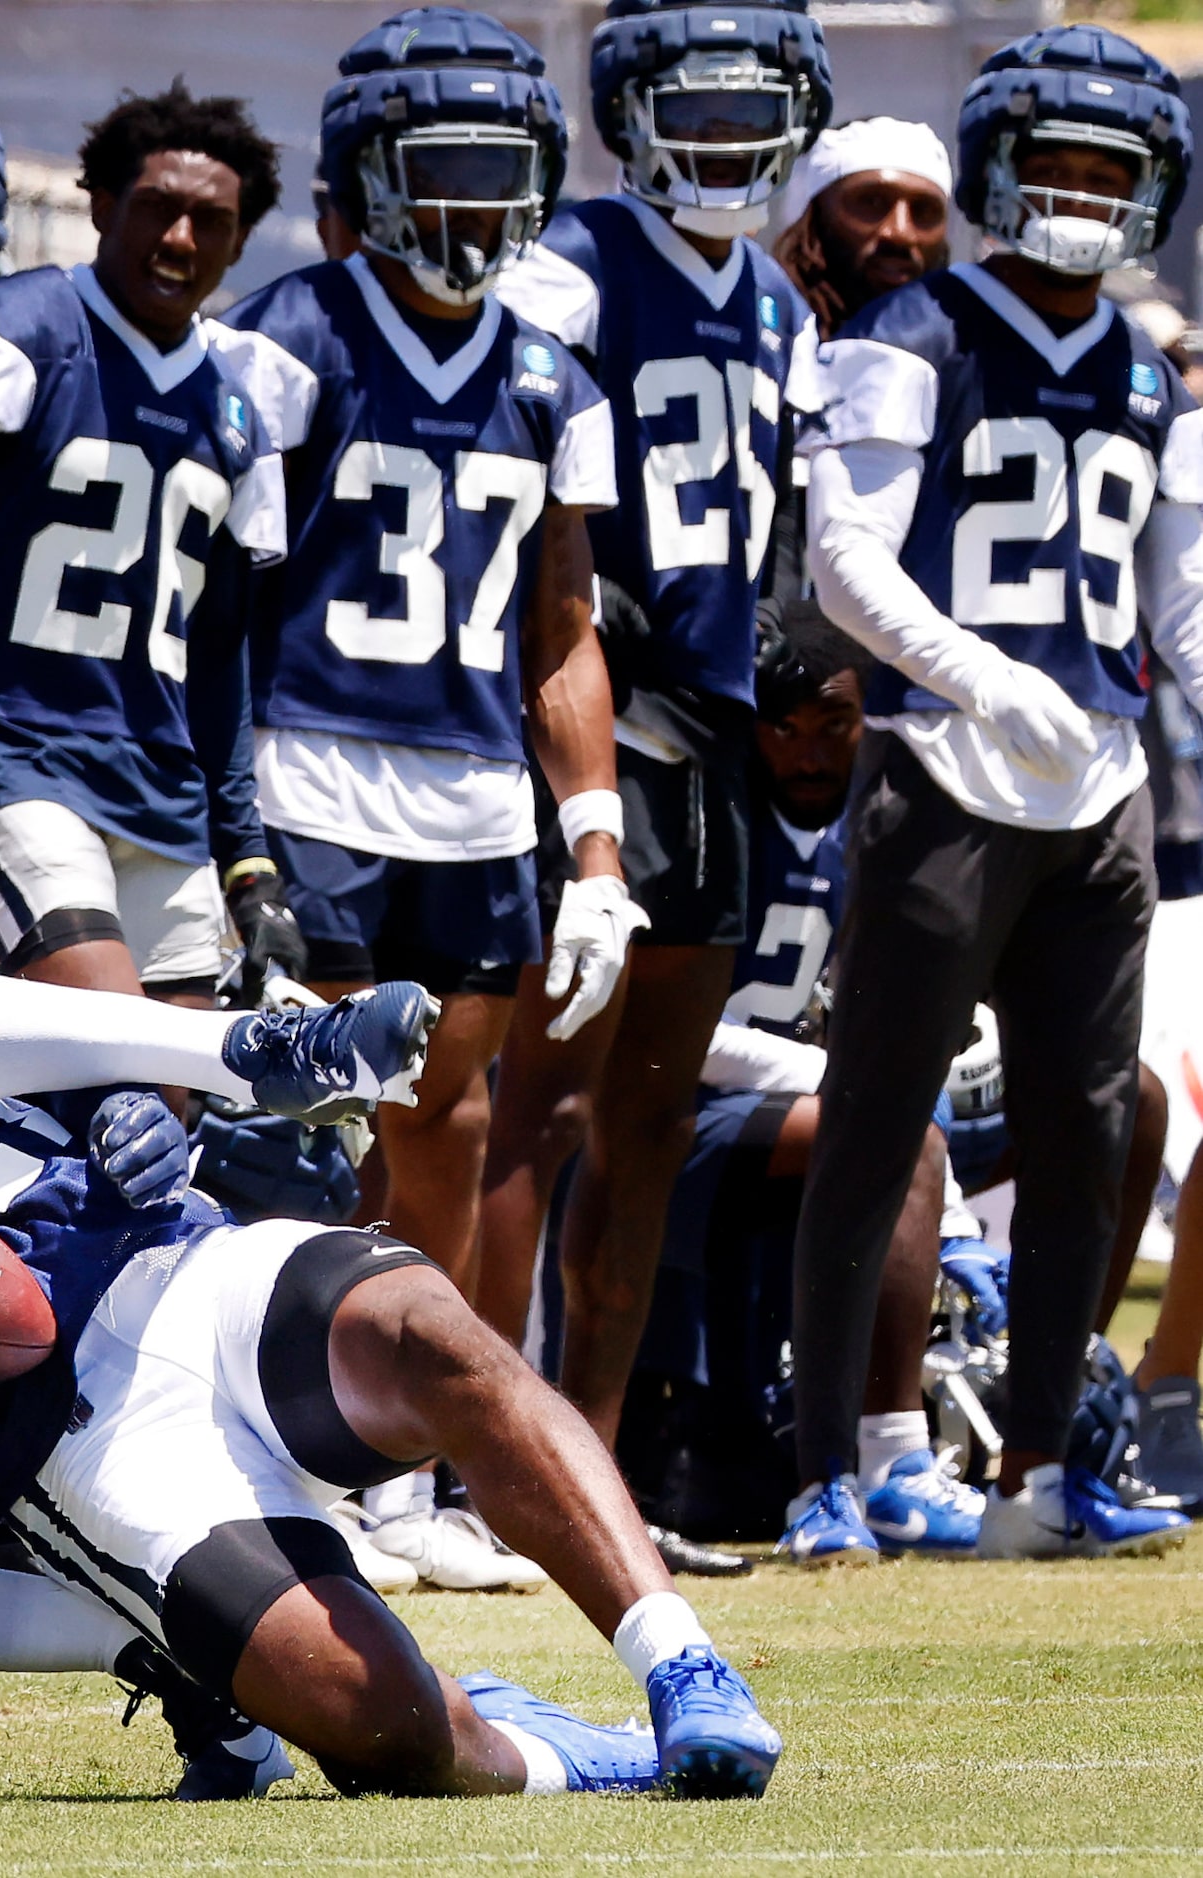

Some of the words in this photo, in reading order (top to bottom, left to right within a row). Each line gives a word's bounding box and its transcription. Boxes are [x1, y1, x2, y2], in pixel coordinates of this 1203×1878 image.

[516, 372, 559, 395] AT&T
[9, 437, 233, 683] 26
[326, 440, 546, 672] 37
[951, 417, 1159, 650] 29
